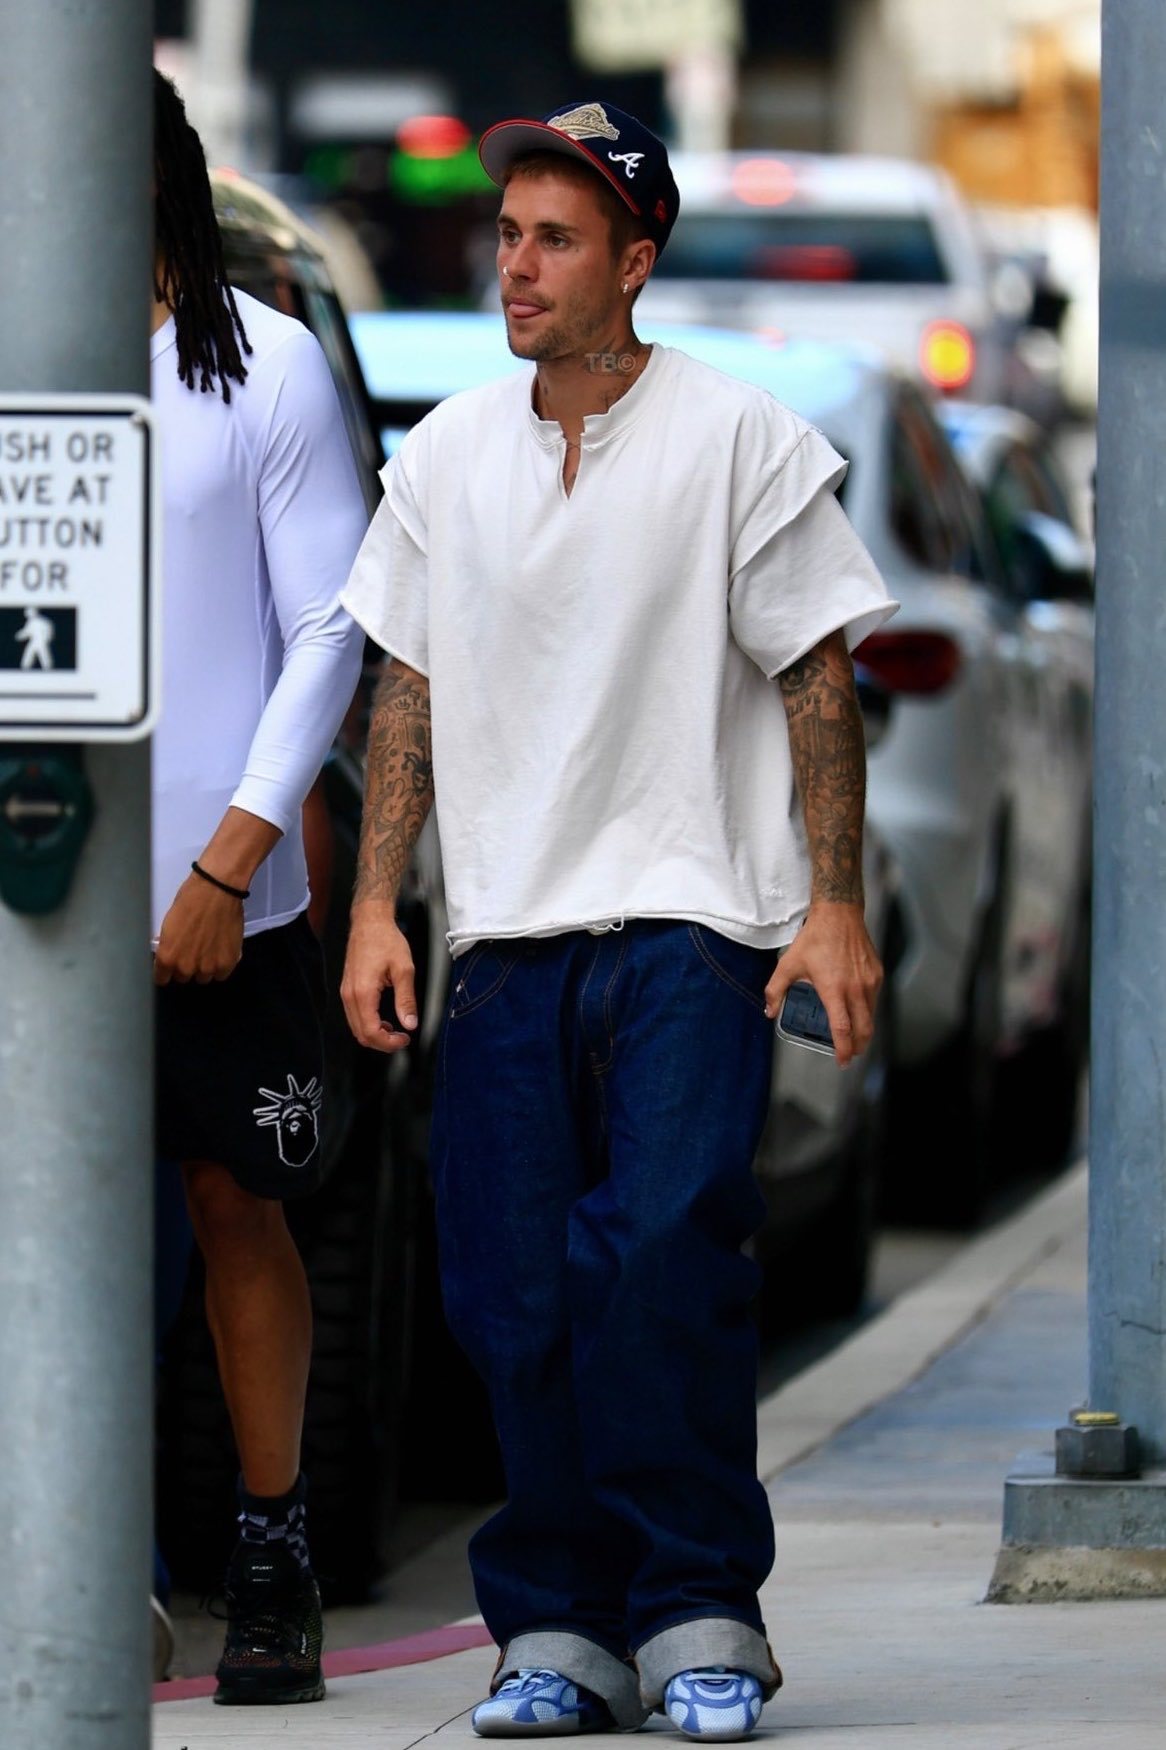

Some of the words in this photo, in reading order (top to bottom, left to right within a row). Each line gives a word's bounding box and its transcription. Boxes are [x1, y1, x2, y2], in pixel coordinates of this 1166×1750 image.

[608, 151, 645, 179] A
[0, 432, 50, 463] SH
[66, 432, 114, 463] OR
[69, 475, 111, 505] AT
[0, 561, 69, 592] FOR
